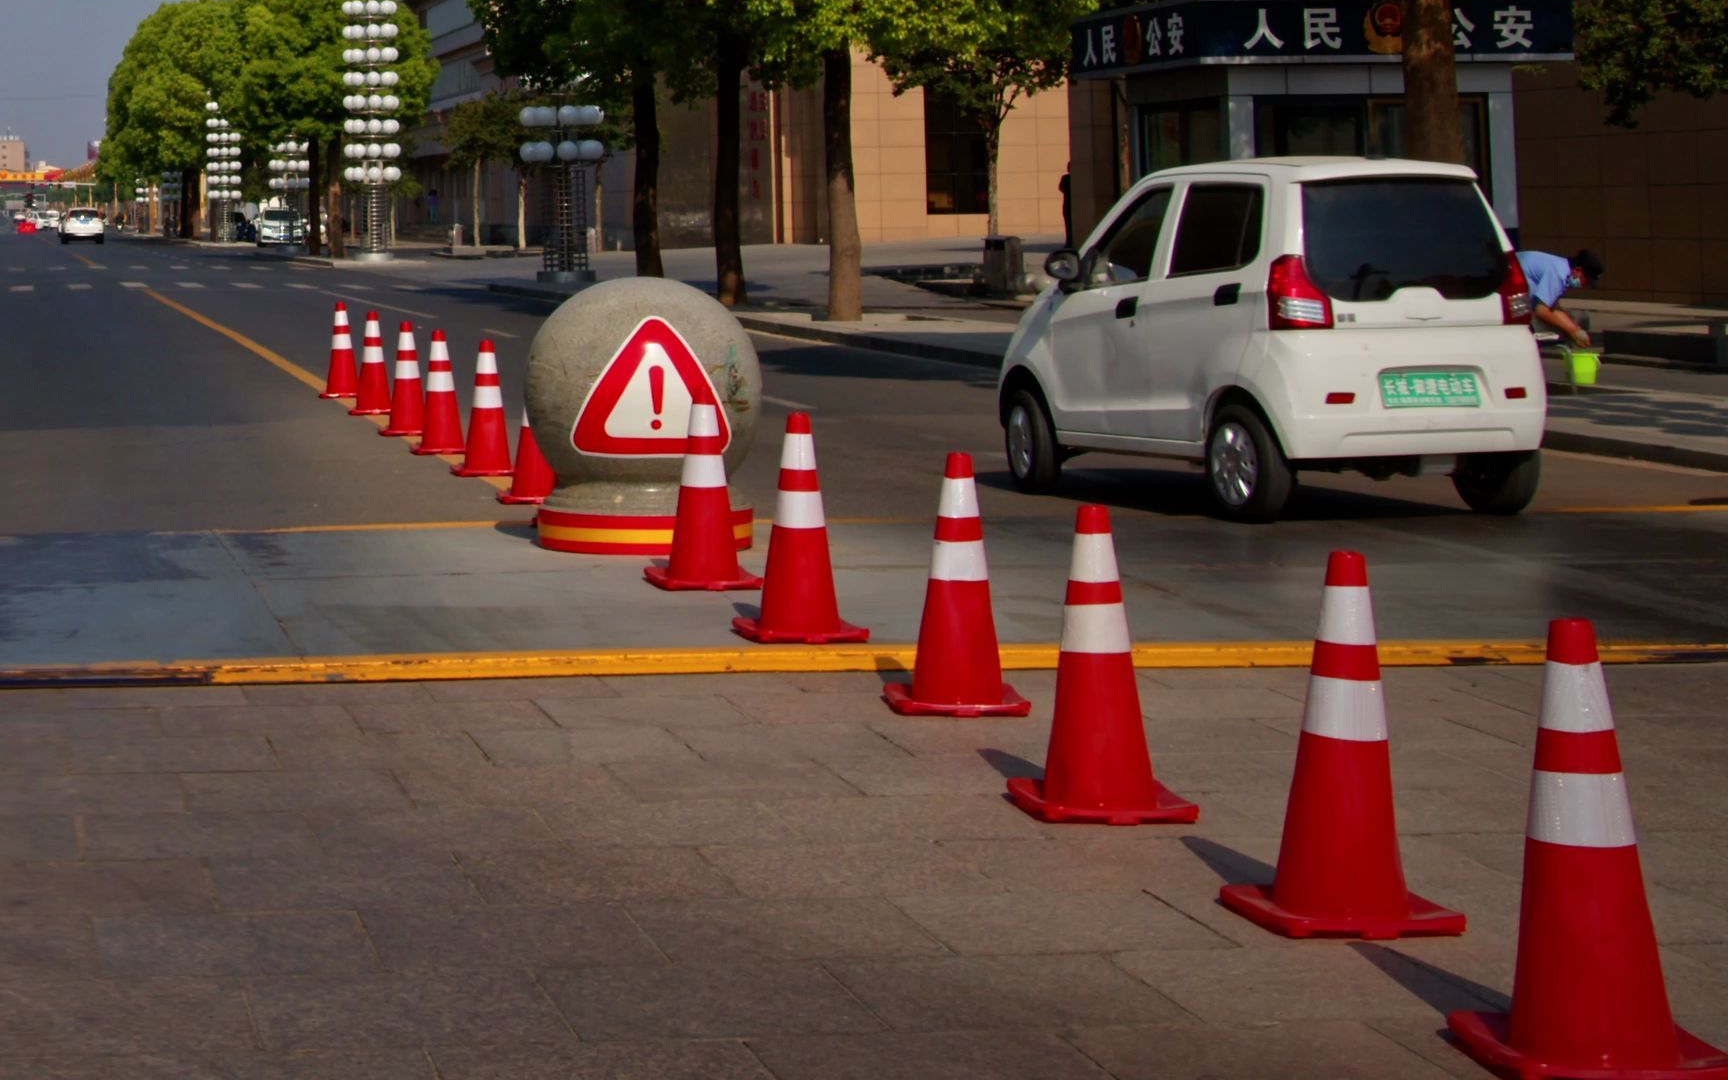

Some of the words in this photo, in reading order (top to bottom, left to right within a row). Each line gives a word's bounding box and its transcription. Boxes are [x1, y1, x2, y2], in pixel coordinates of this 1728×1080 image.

[1083, 24, 1116, 68] 人民
[1145, 12, 1185, 58] 公安
[1243, 7, 1343, 51] 人民
